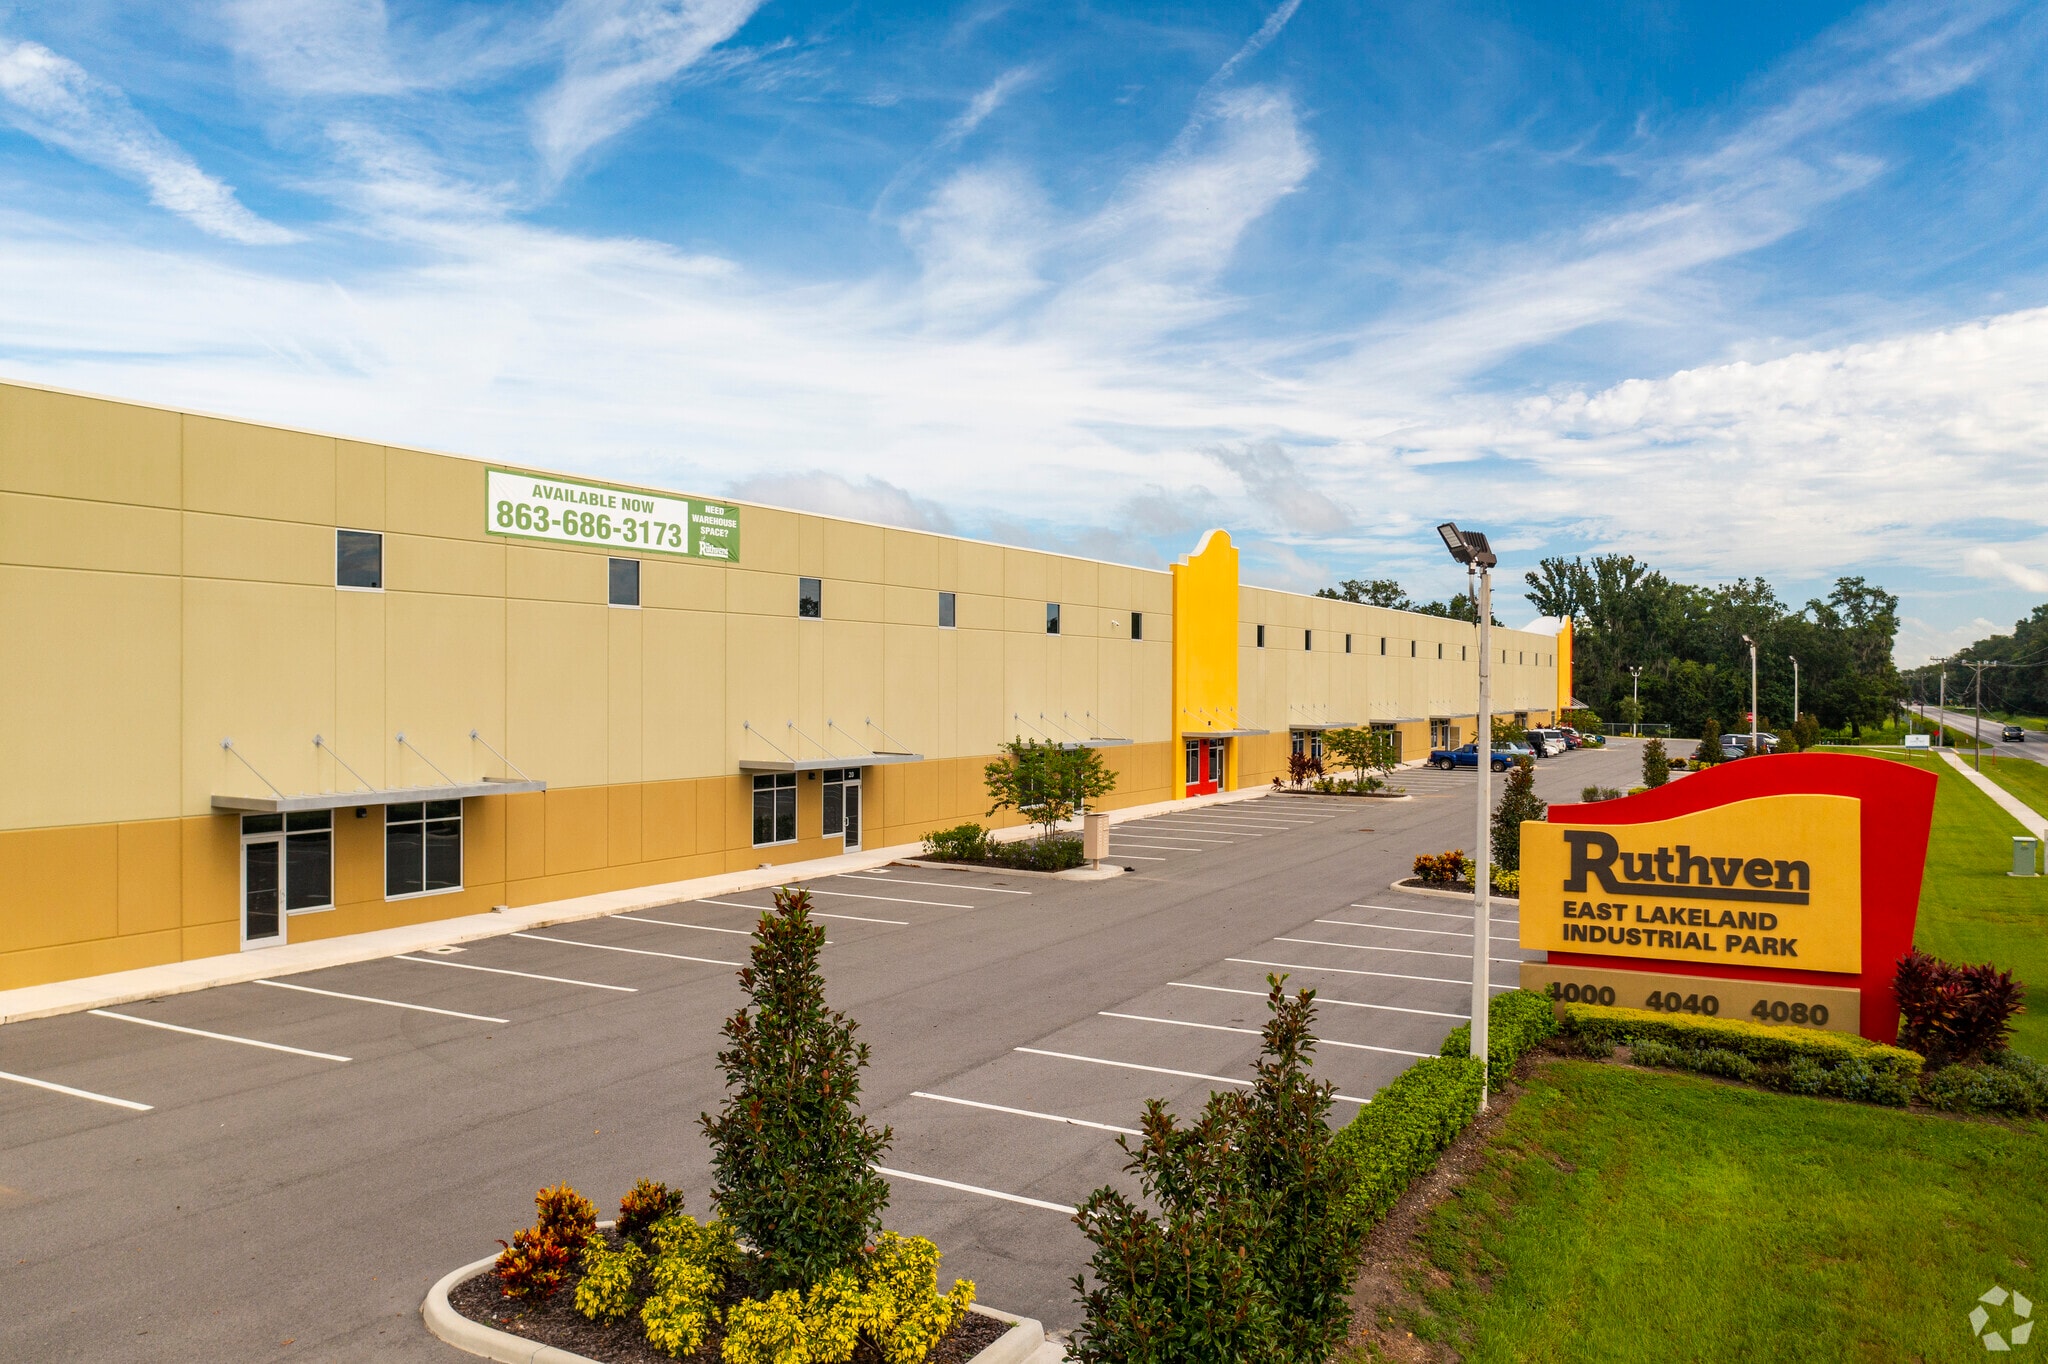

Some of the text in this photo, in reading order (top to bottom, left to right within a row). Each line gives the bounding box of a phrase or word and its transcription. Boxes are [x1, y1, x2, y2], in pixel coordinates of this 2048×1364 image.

[532, 484, 654, 513] AVAILABLE NOW
[705, 505, 725, 515] NEED
[496, 500, 682, 548] 863-686-3173
[691, 514, 737, 528] WAREHOUSE
[700, 526, 729, 538] SPACE?
[1563, 829, 1810, 905] Ruthven
[1563, 900, 1778, 931] EAST LAKELAND
[1563, 923, 1798, 957] INDUSTRIAL PARK
[1550, 982, 1829, 1026] 4000 4040 4080
